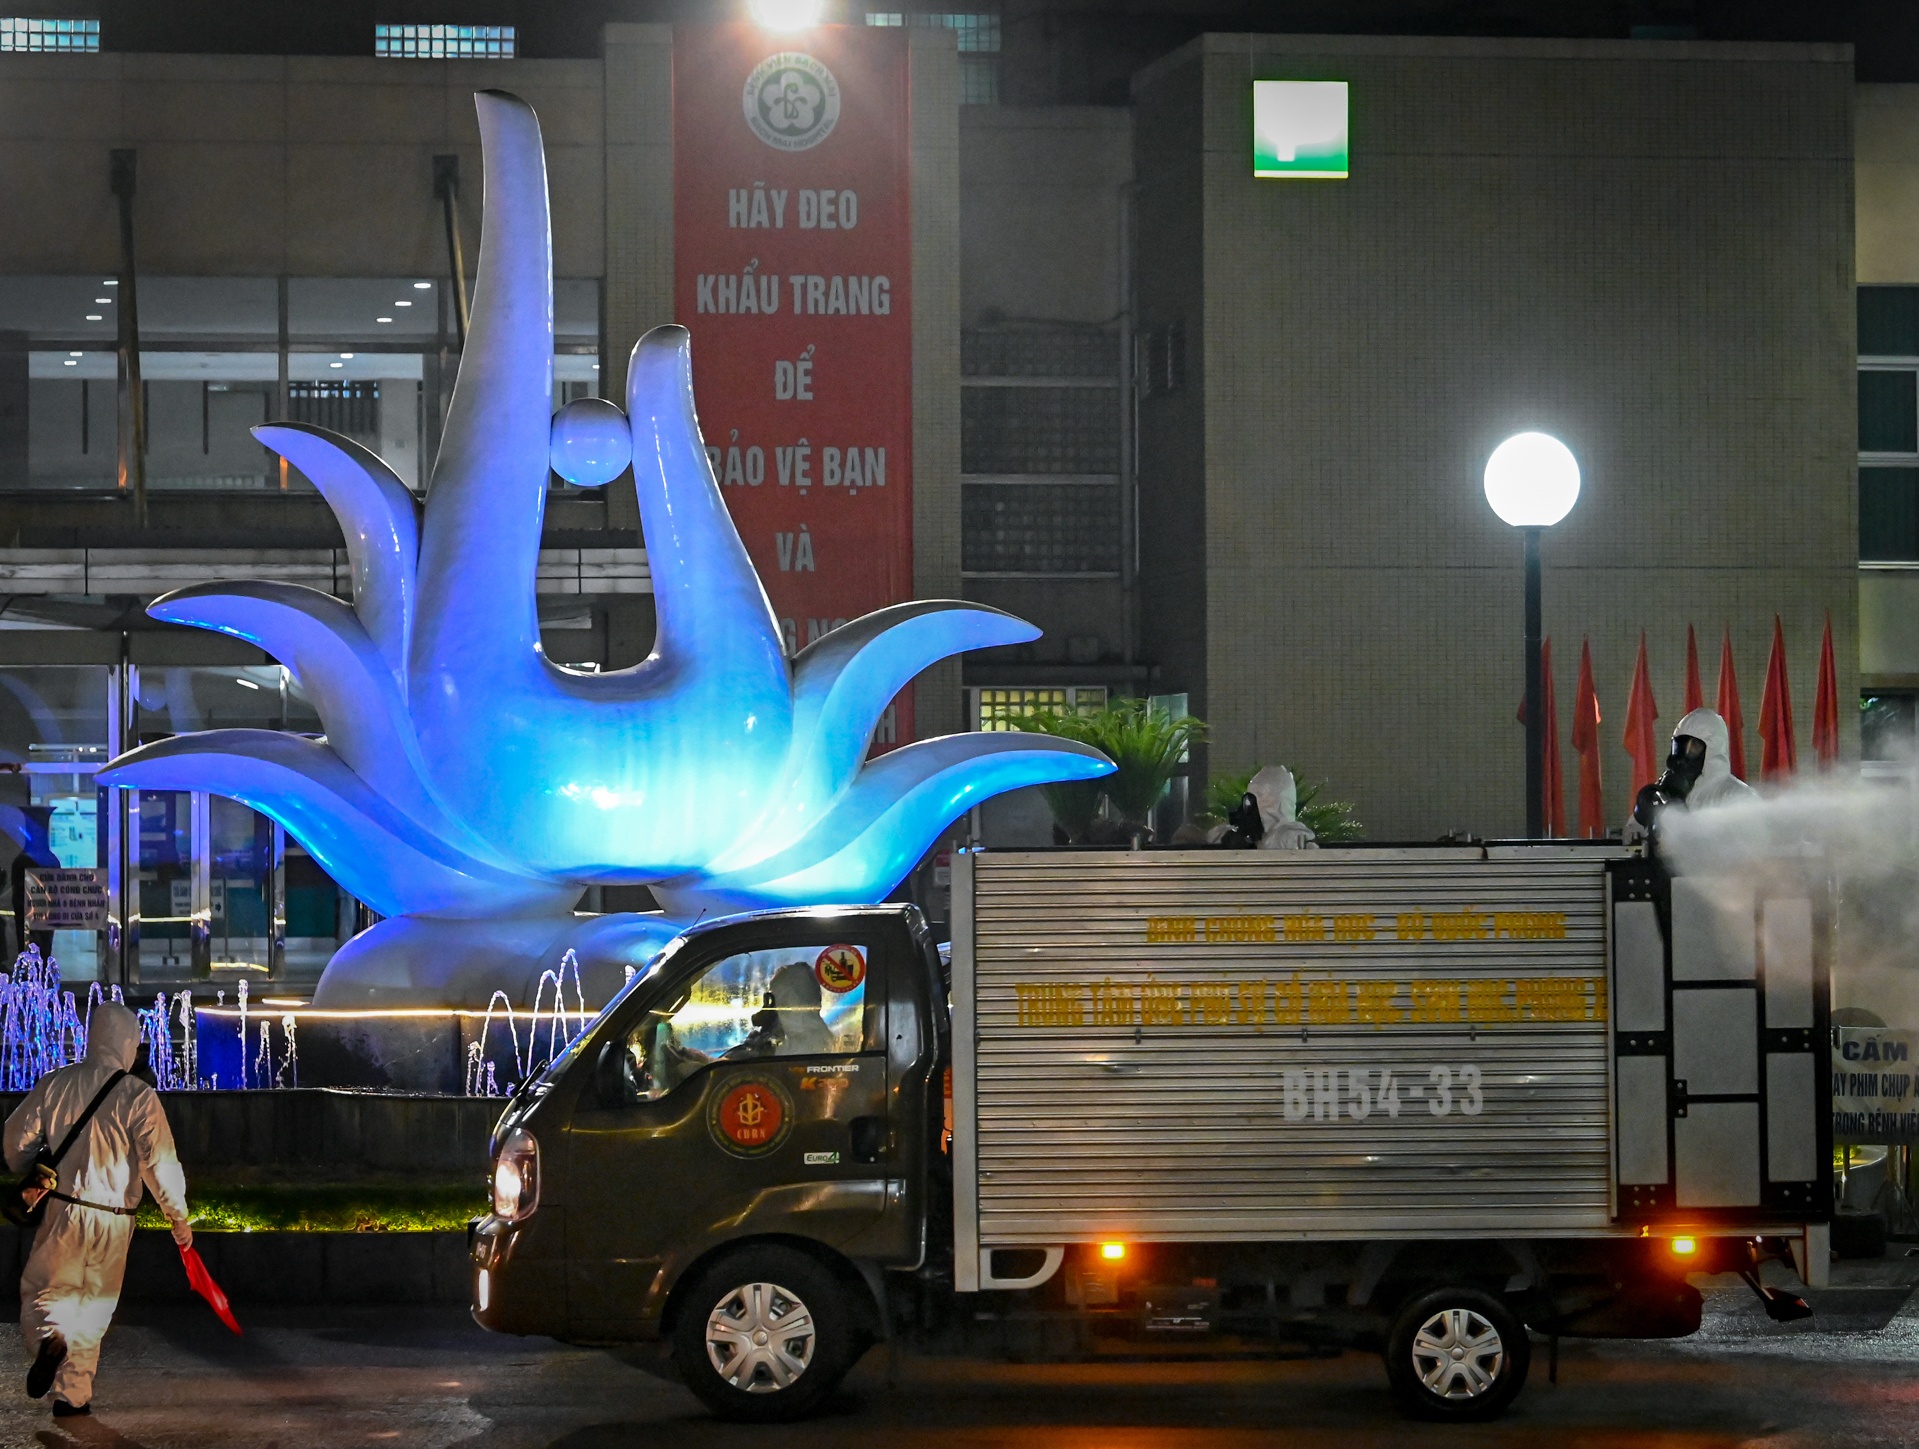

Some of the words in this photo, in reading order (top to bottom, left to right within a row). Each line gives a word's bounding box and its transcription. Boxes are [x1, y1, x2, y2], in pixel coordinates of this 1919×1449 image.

[729, 180, 788, 229] HÃY
[798, 188, 858, 230] ĐEO
[697, 257, 779, 315] KHẨU
[789, 274, 891, 316] TRANG
[774, 343, 815, 400] ĐỂ
[775, 437, 812, 495] VỆ
[822, 446, 886, 496] BẠN
[775, 522, 815, 572] VÀ
[806, 1064, 860, 1073] FRONTIER
[1842, 1033, 1908, 1061] CẤM
[1850, 1072, 1878, 1097] PHIM
[1881, 1073, 1911, 1102] CHỤP
[736, 1128, 766, 1139] CBRN
